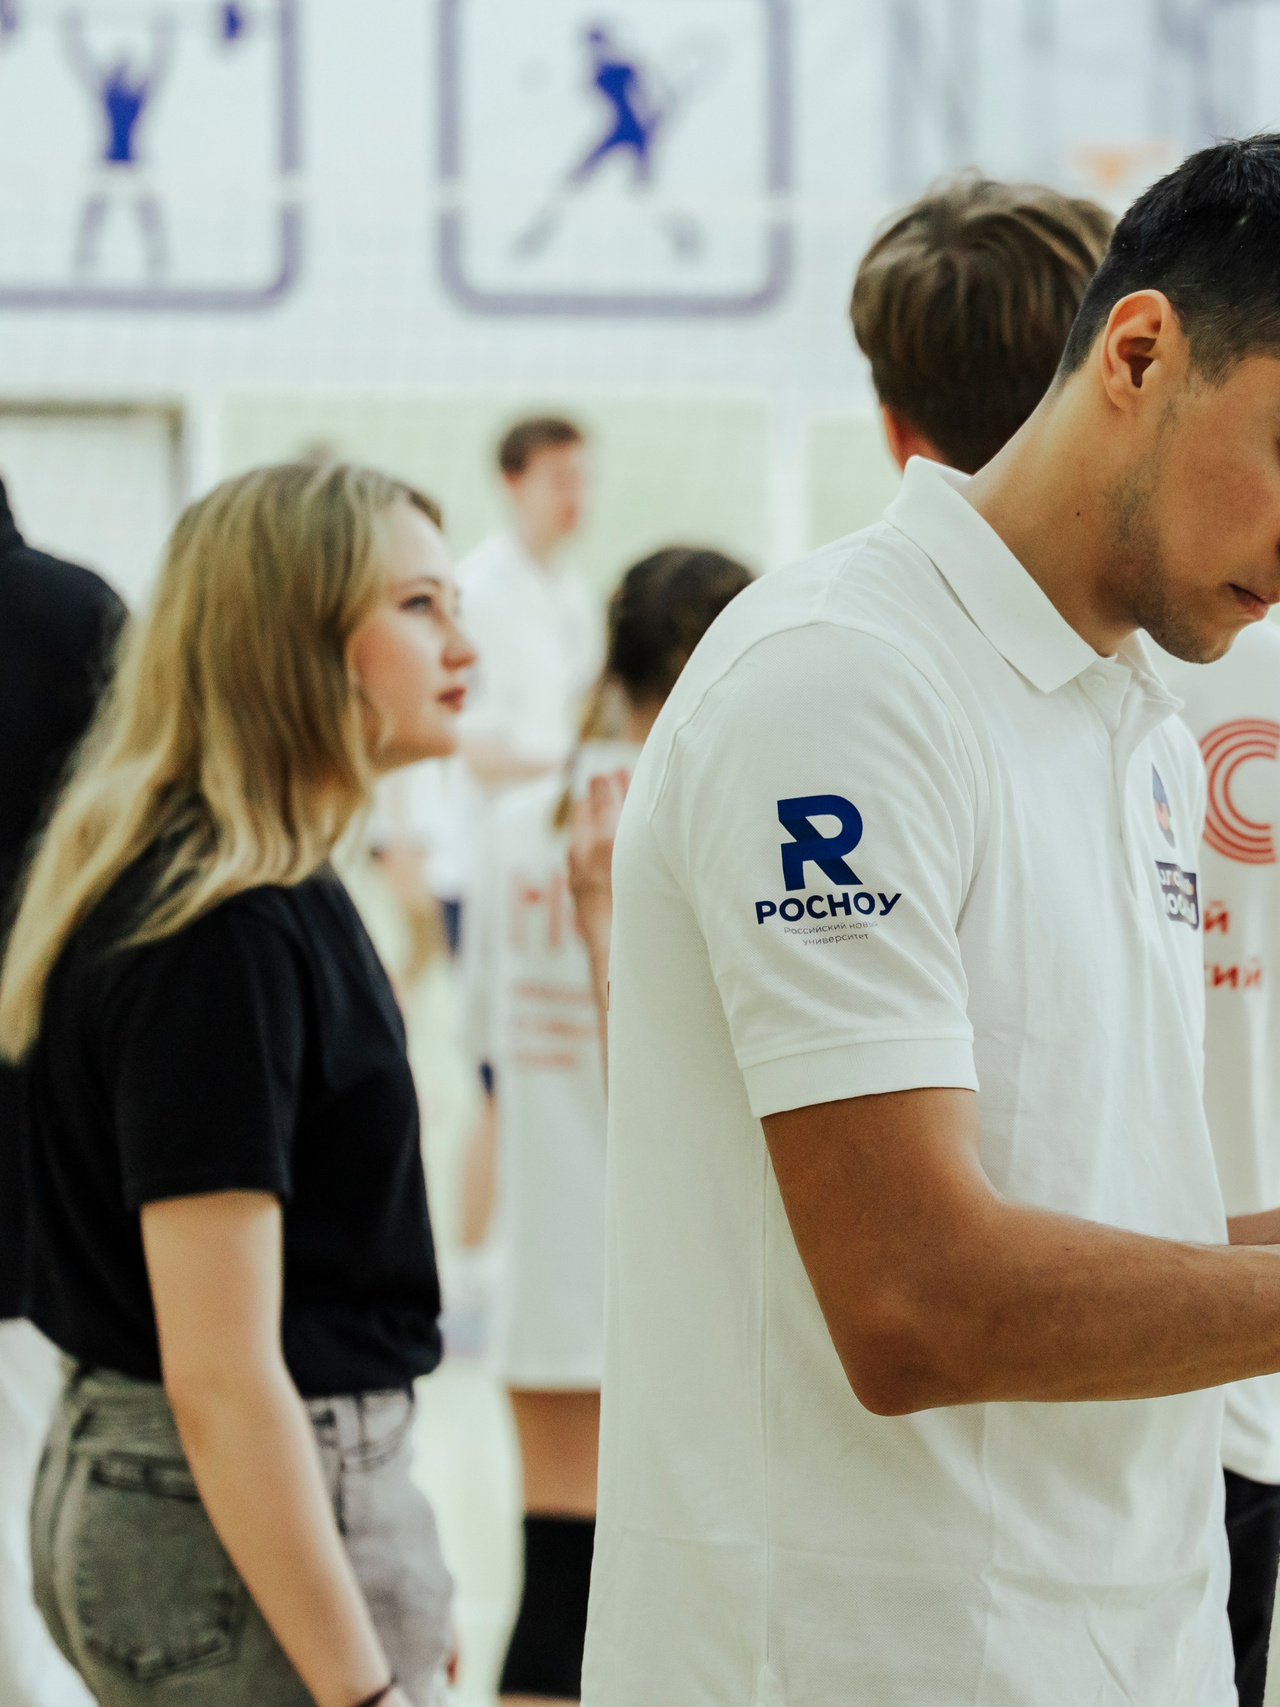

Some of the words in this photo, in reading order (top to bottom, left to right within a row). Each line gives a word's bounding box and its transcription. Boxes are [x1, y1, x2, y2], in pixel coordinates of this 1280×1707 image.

[755, 892, 902, 925] РОСНОУ
[784, 922, 847, 935] Российский
[802, 932, 869, 947] университет
